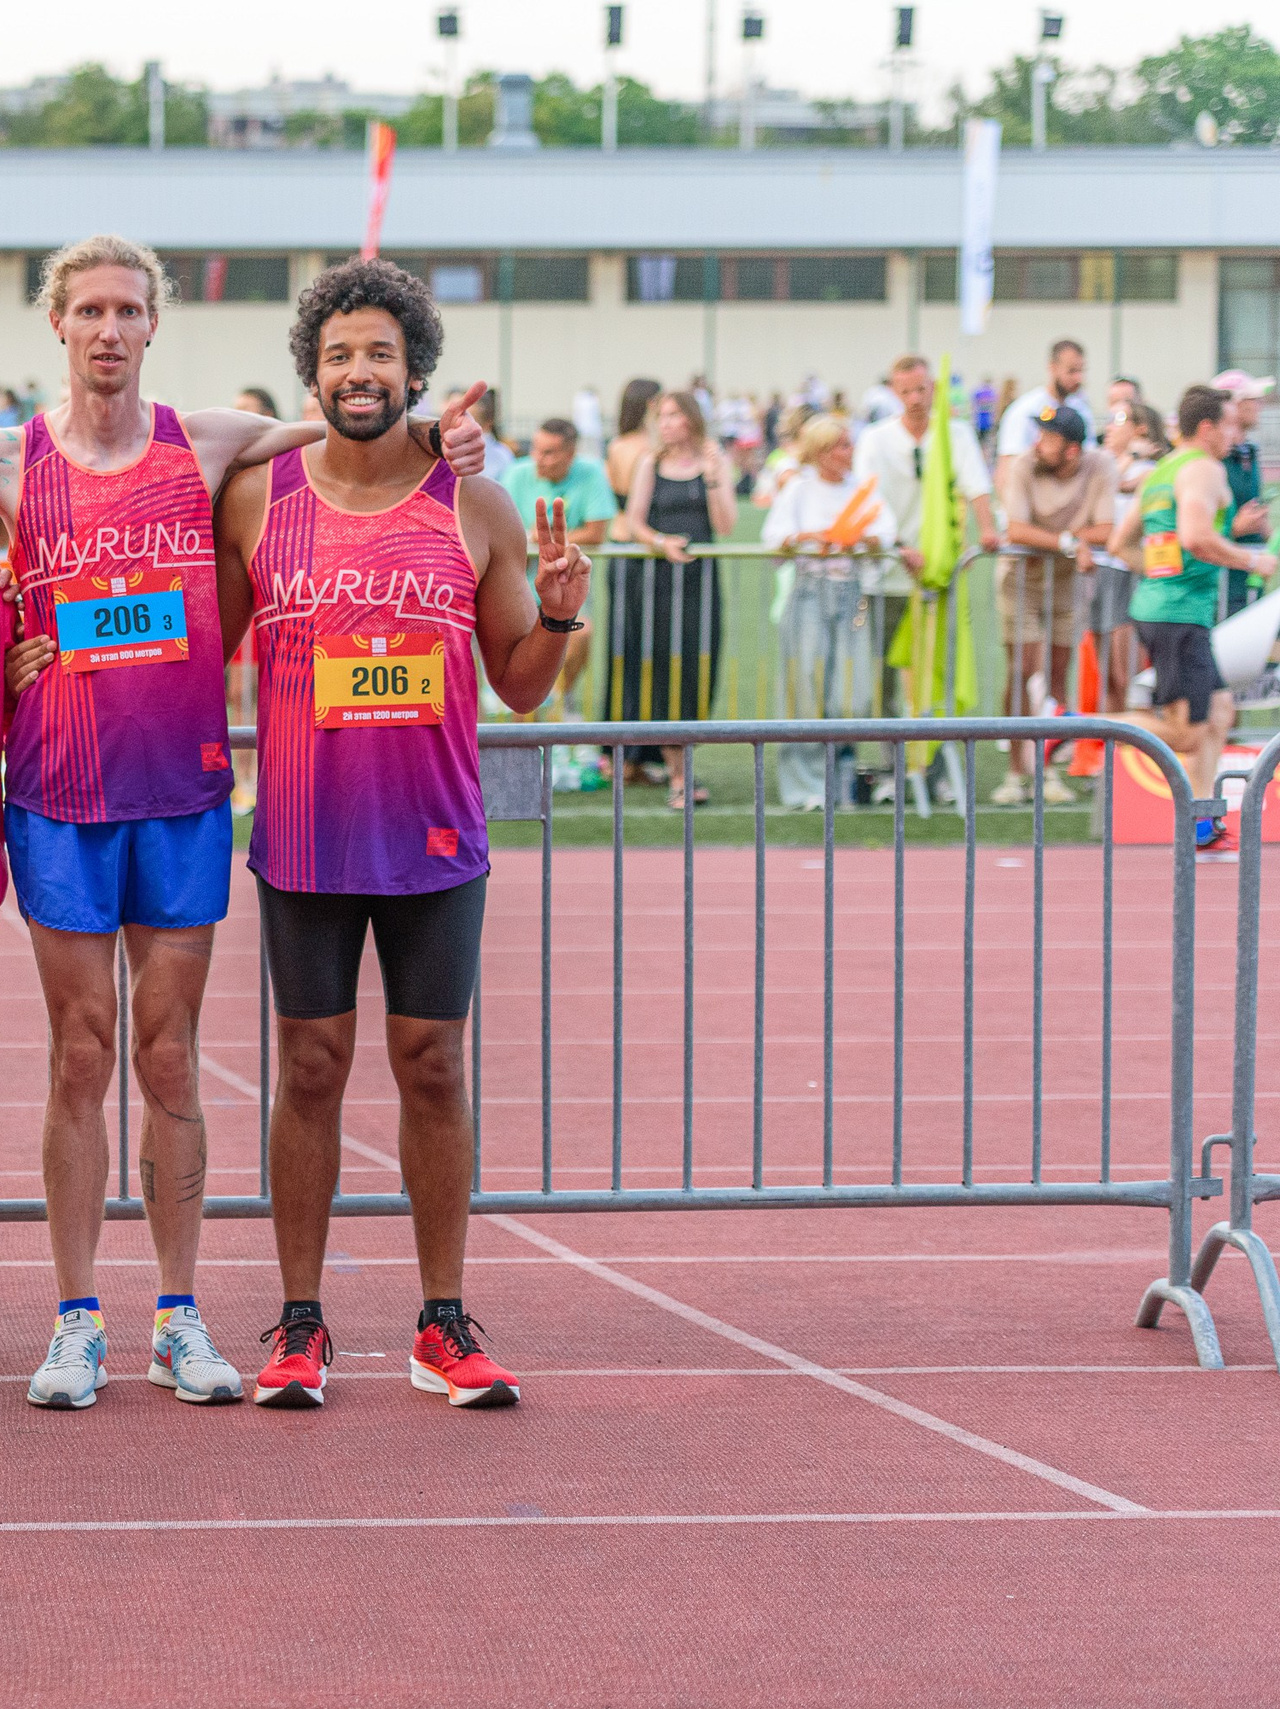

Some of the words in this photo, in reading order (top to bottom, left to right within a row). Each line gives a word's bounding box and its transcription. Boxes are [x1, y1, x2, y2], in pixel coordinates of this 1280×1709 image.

[93, 603, 151, 638] 206
[163, 614, 173, 631] 3
[135, 647, 163, 659] метров
[352, 665, 409, 697] 206
[421, 678, 431, 695] 2
[373, 710, 390, 720] 1200
[391, 710, 419, 720] метров
